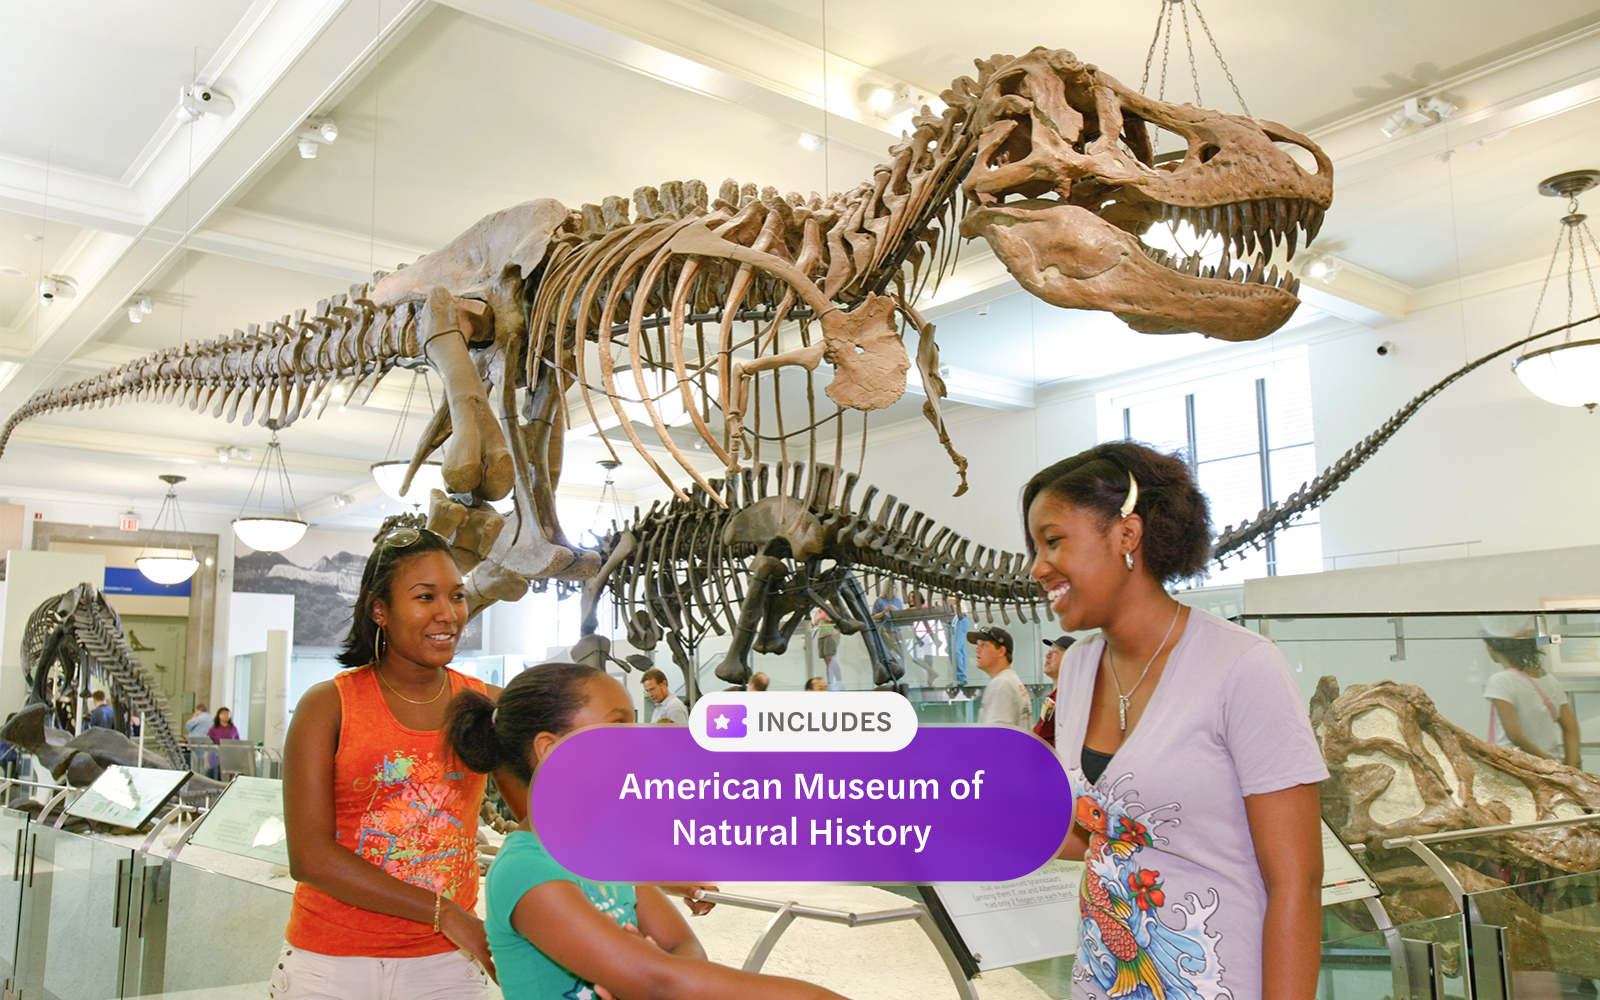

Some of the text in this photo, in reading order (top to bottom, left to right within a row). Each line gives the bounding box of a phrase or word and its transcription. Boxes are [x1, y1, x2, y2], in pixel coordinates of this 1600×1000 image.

[123, 519, 137, 530] EXIT
[1059, 864, 1081, 873] showed
[996, 890, 1011, 898] them
[1028, 886, 1039, 894] and
[984, 900, 998, 909] had
[998, 899, 1011, 908] only
[1016, 895, 1036, 905] fingers
[1045, 892, 1059, 900] each
